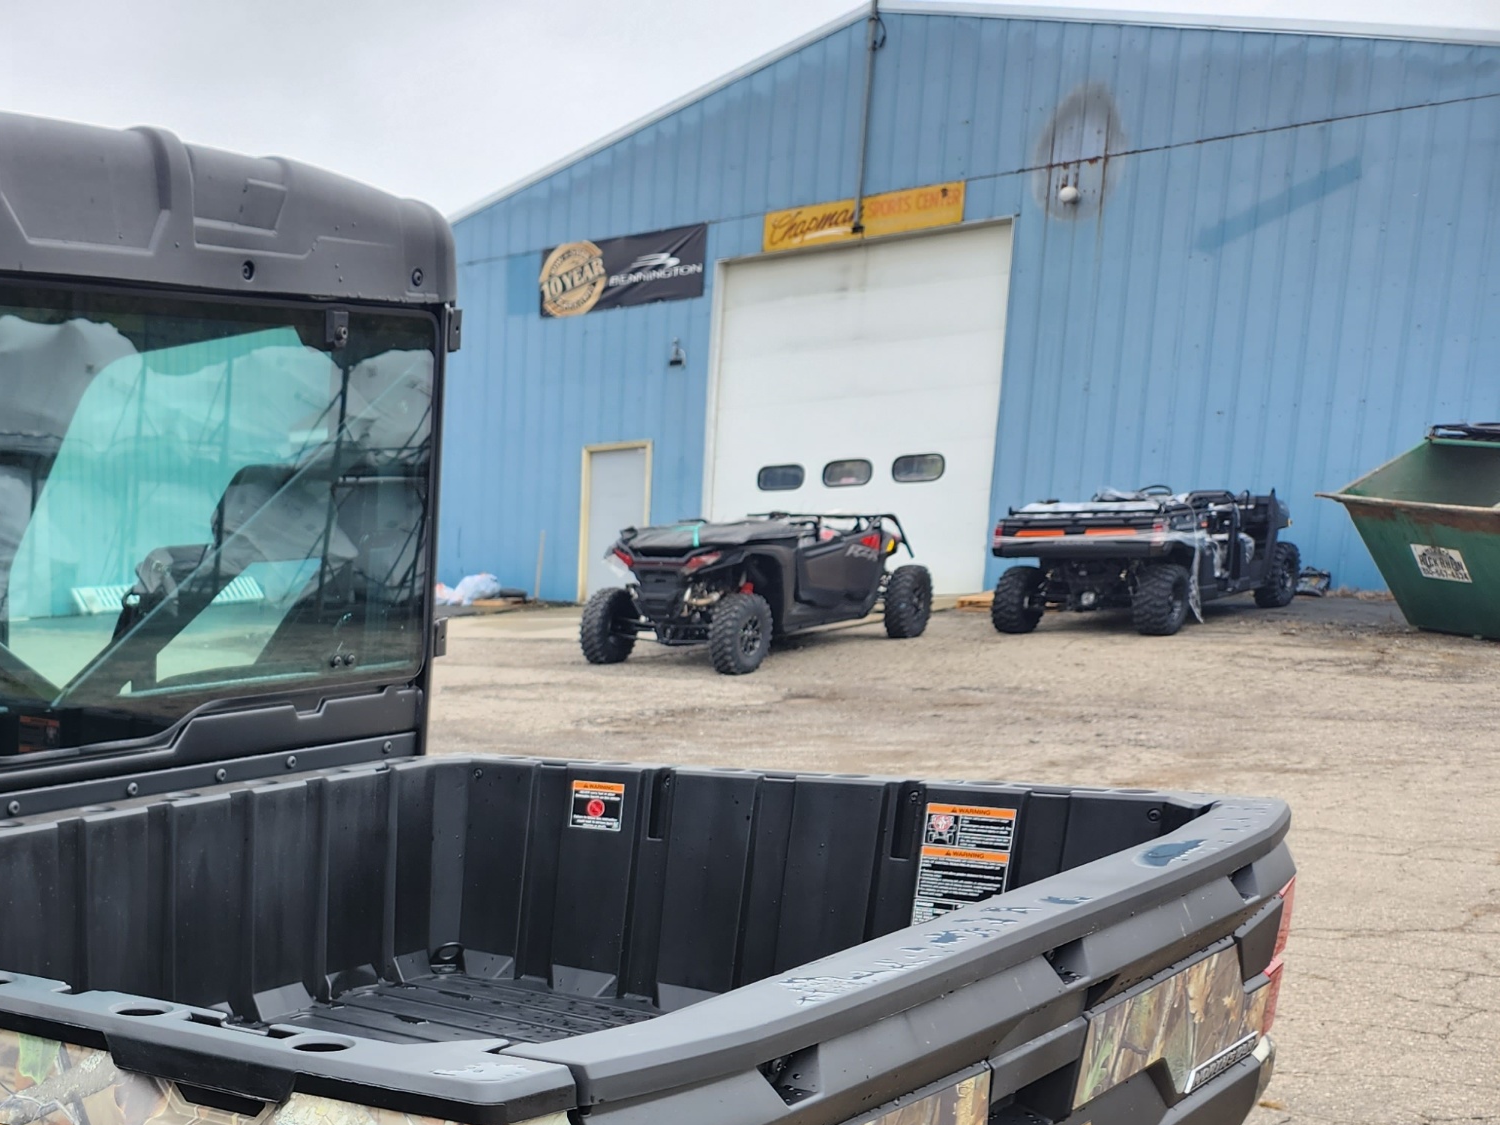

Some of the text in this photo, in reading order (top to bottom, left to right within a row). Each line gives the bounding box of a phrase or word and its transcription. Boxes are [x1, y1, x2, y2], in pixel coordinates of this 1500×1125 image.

[867, 195, 912, 219] SPORTS
[916, 188, 961, 210] CENTER
[541, 280, 564, 303] 10
[562, 257, 606, 295] YEAR
[609, 263, 703, 287] BENNINGTON
[958, 808, 991, 816] WARNING
[952, 850, 985, 859] WARNING
